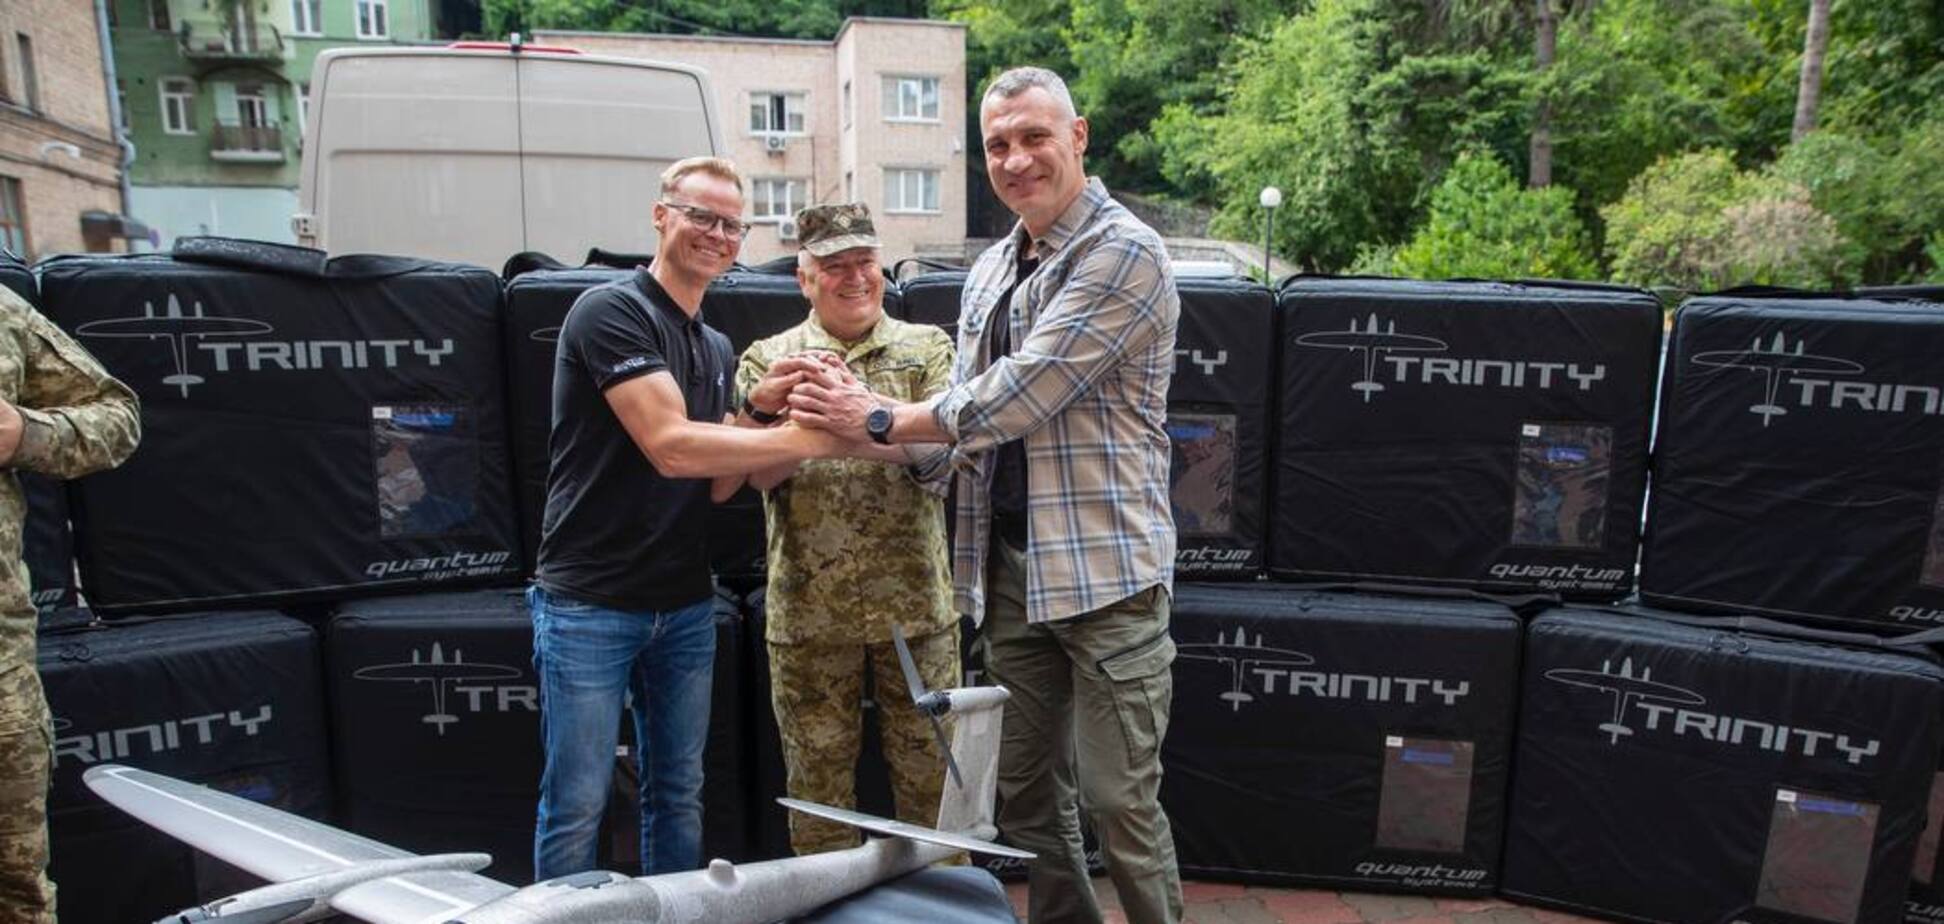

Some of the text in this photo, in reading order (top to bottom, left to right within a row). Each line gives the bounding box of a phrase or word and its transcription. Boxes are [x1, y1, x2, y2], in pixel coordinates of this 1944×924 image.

[197, 338, 455, 372] TRINITY
[1384, 355, 1606, 391] TRINITY
[1789, 377, 1944, 416] TRIN
[365, 551, 512, 579] quantum
[1176, 545, 1253, 561] ntum
[1489, 563, 1626, 581] quantum
[1252, 667, 1470, 706] TRINITY
[52, 705, 273, 768] RINITY
[1637, 702, 1881, 765] TRINITY
[1355, 862, 1489, 881] quantum
